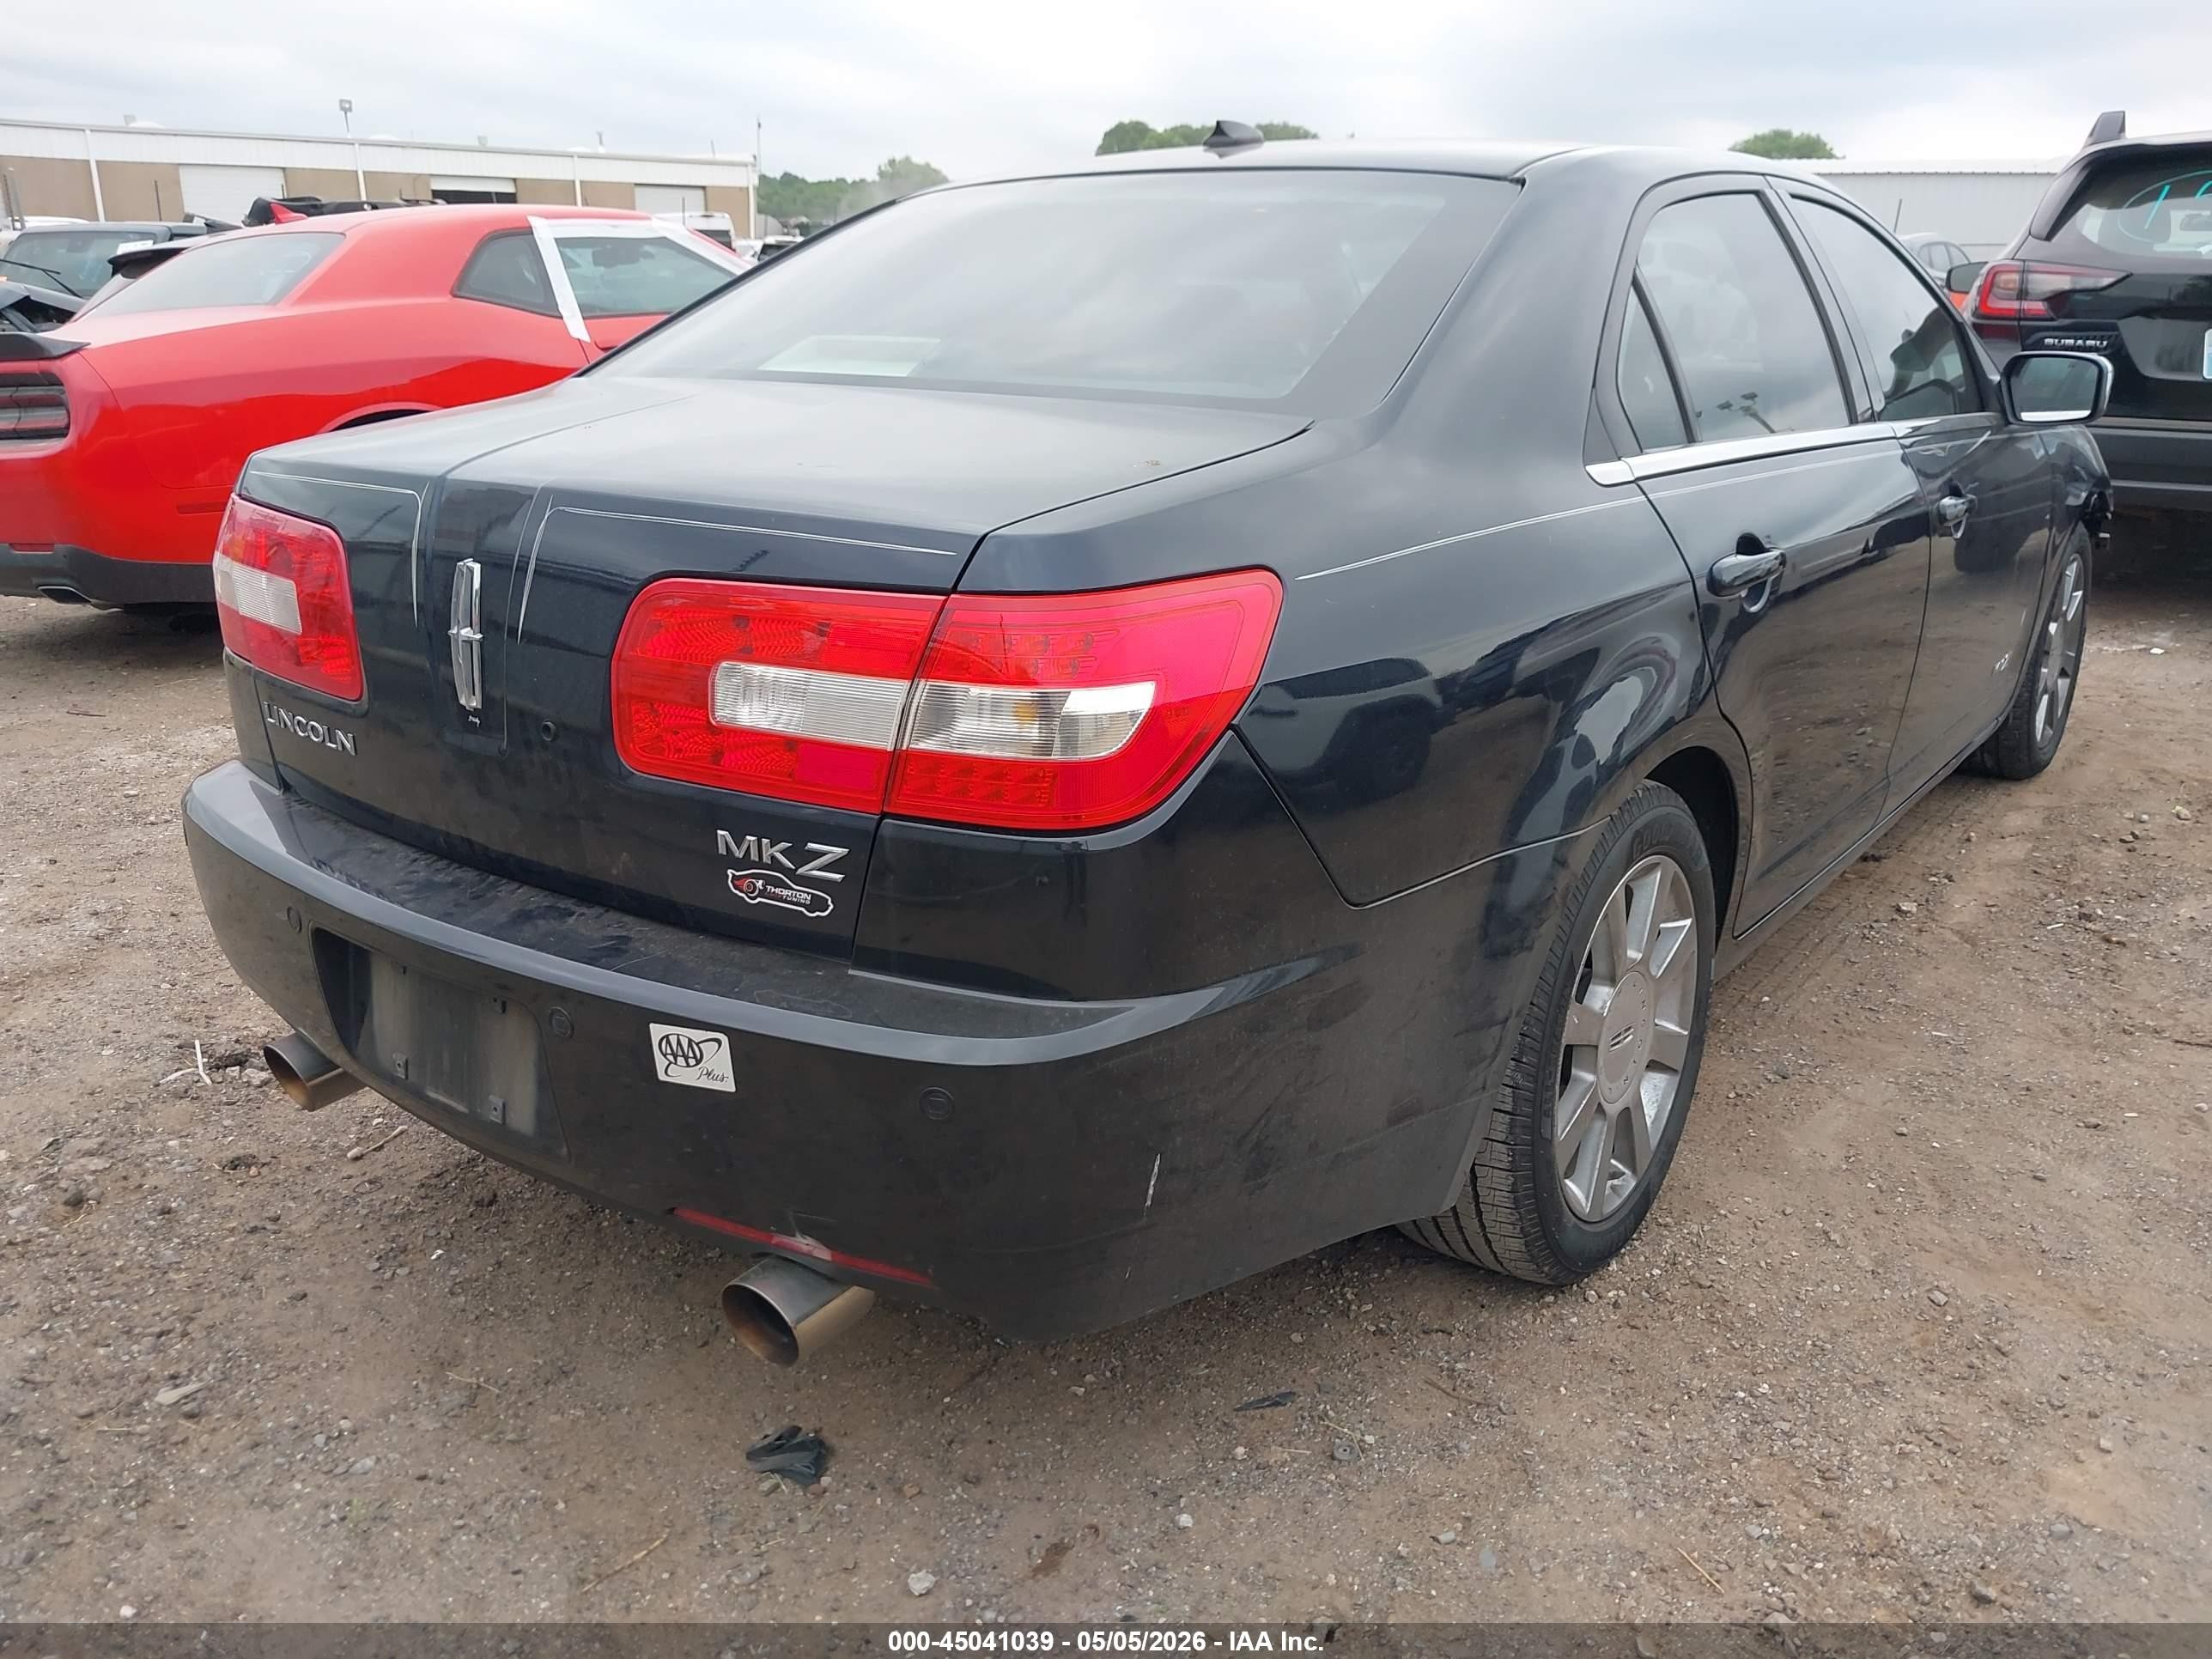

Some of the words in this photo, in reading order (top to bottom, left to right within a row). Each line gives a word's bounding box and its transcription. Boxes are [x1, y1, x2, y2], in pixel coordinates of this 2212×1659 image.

[2044, 337, 2108, 349] SUBARU
[263, 701, 356, 756] LINCOLN
[766, 885, 811, 901] THORTON
[664, 1034, 702, 1066] AAA
